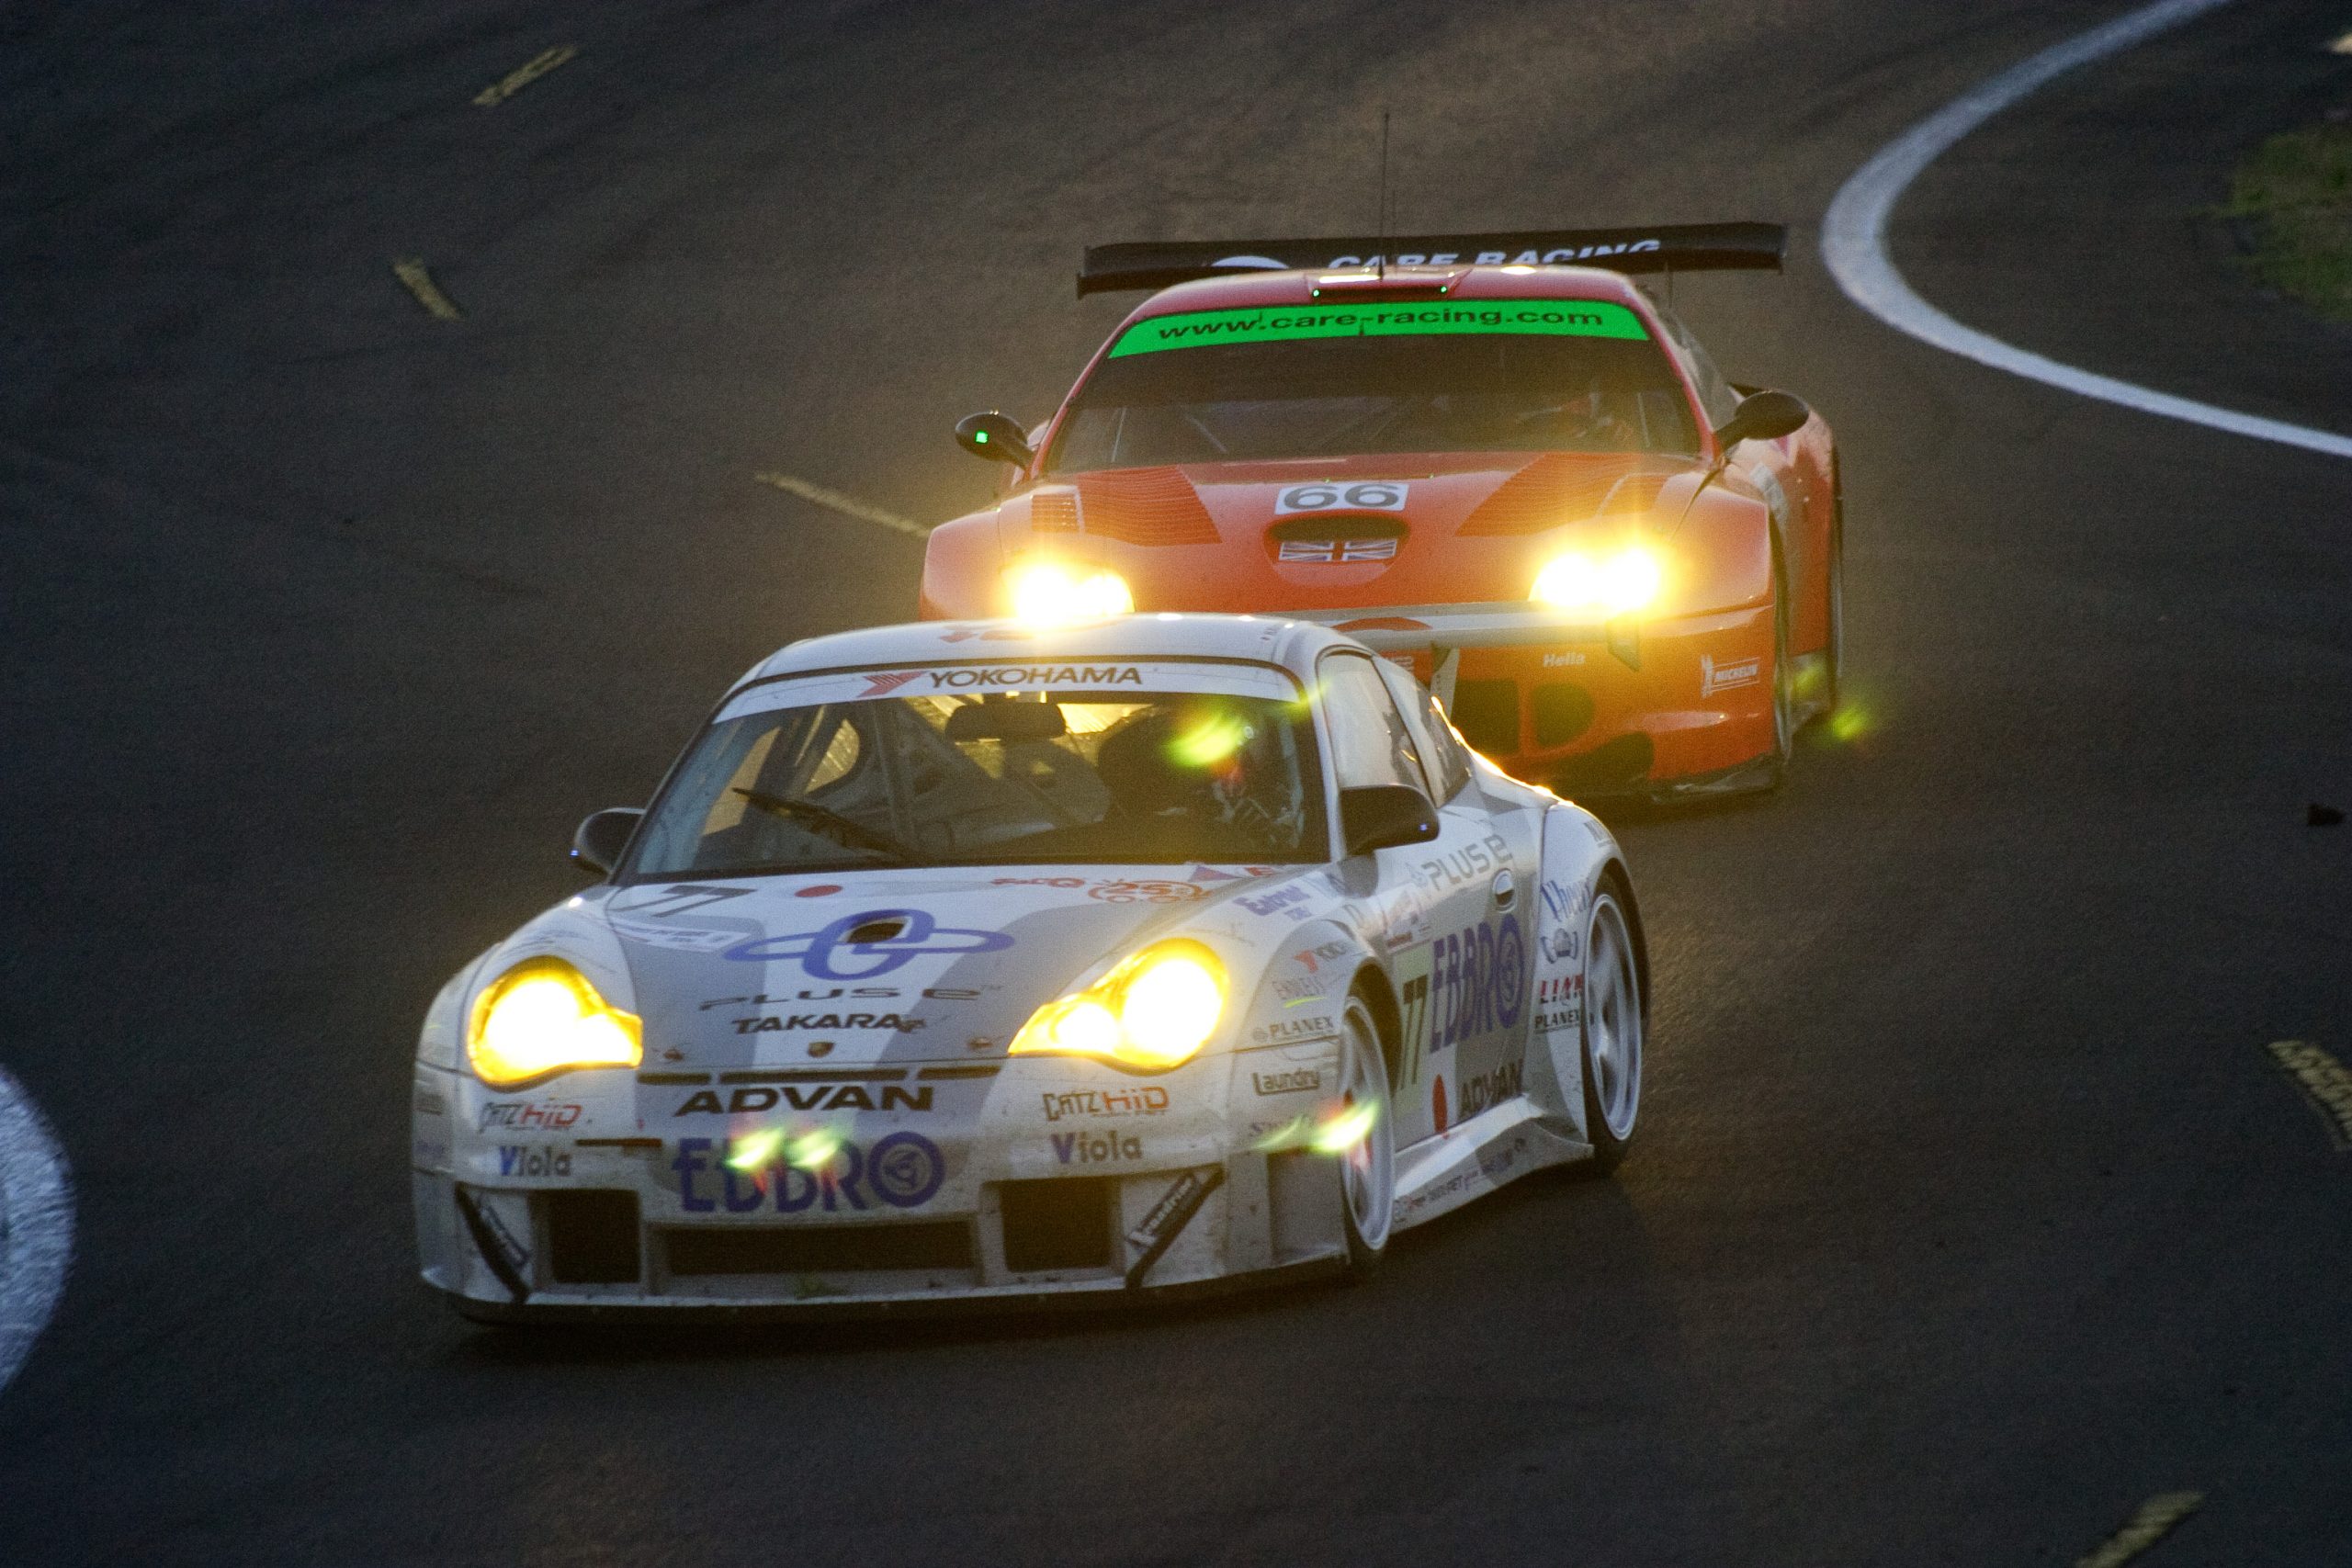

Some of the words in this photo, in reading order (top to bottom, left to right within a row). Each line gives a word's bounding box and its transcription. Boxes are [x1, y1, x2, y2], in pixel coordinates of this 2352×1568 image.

[1158, 306, 1603, 340] www.care-racing.com
[1283, 484, 1400, 510] 66
[930, 666, 1143, 689] YOKOHAMA
[731, 1013, 905, 1035] TAKARA
[1270, 1015, 1334, 1038] PLANEX
[674, 1086, 933, 1117] ADVAN
[1051, 1130, 1142, 1163] Viola
[499, 1145, 571, 1177] Viola
